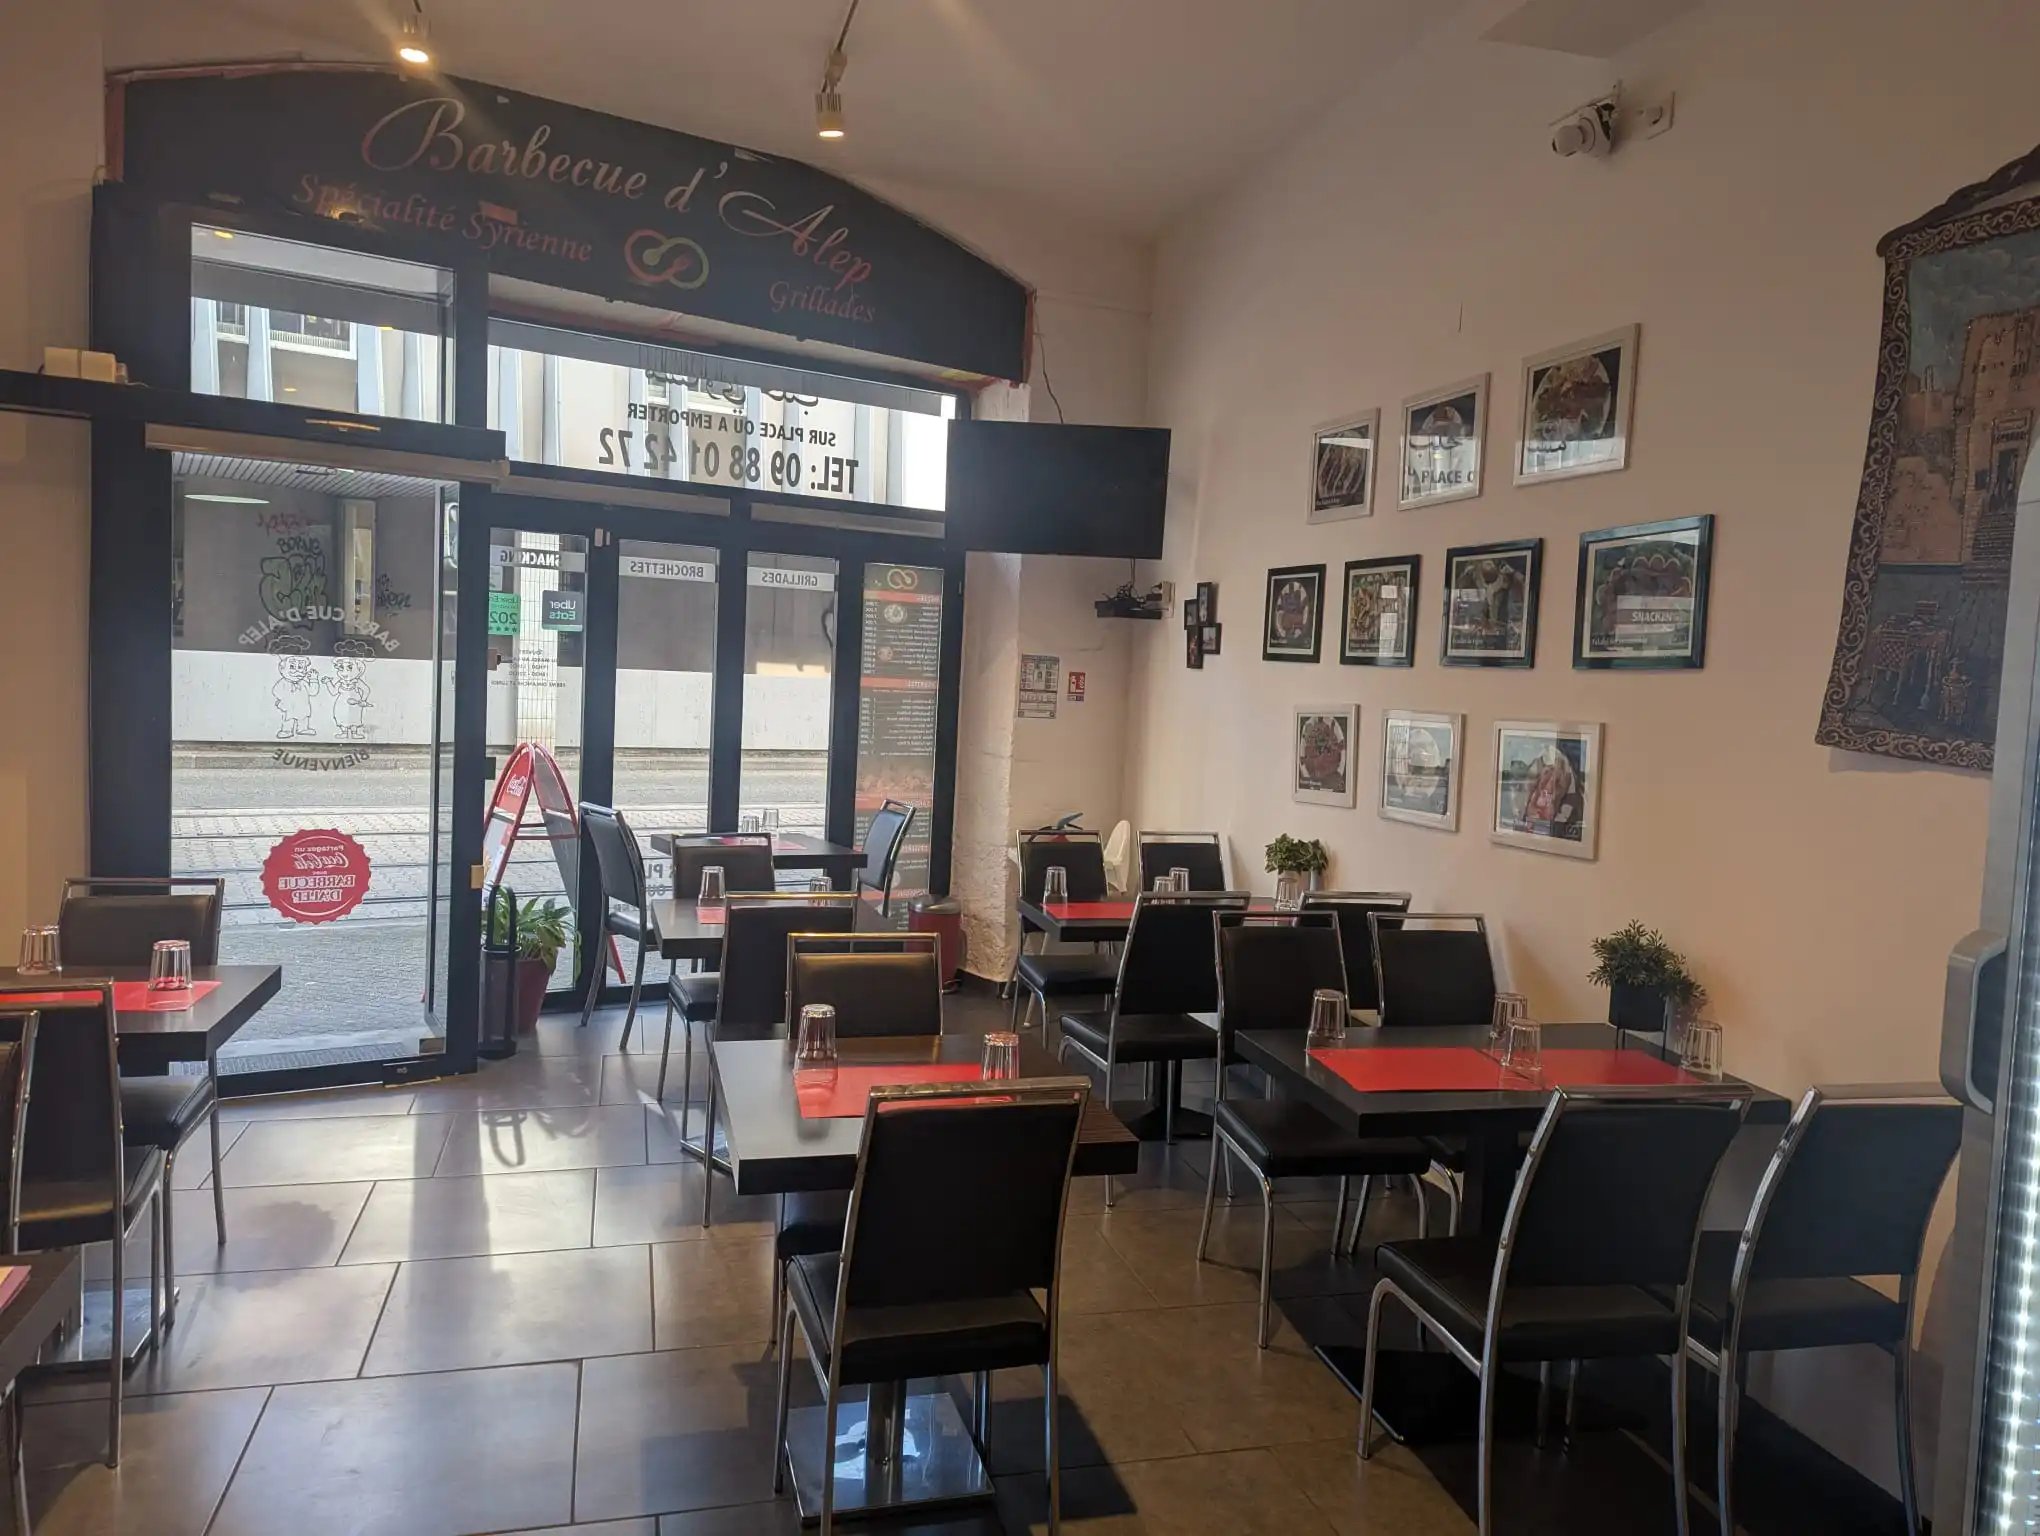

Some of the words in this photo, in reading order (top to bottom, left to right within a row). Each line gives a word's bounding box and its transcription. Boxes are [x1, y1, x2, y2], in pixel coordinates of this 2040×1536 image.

[361, 97, 648, 200] Barbecue
[292, 173, 457, 231] Spécialité
[462, 208, 593, 262] Syrienne
[769, 280, 877, 324] Grillades
